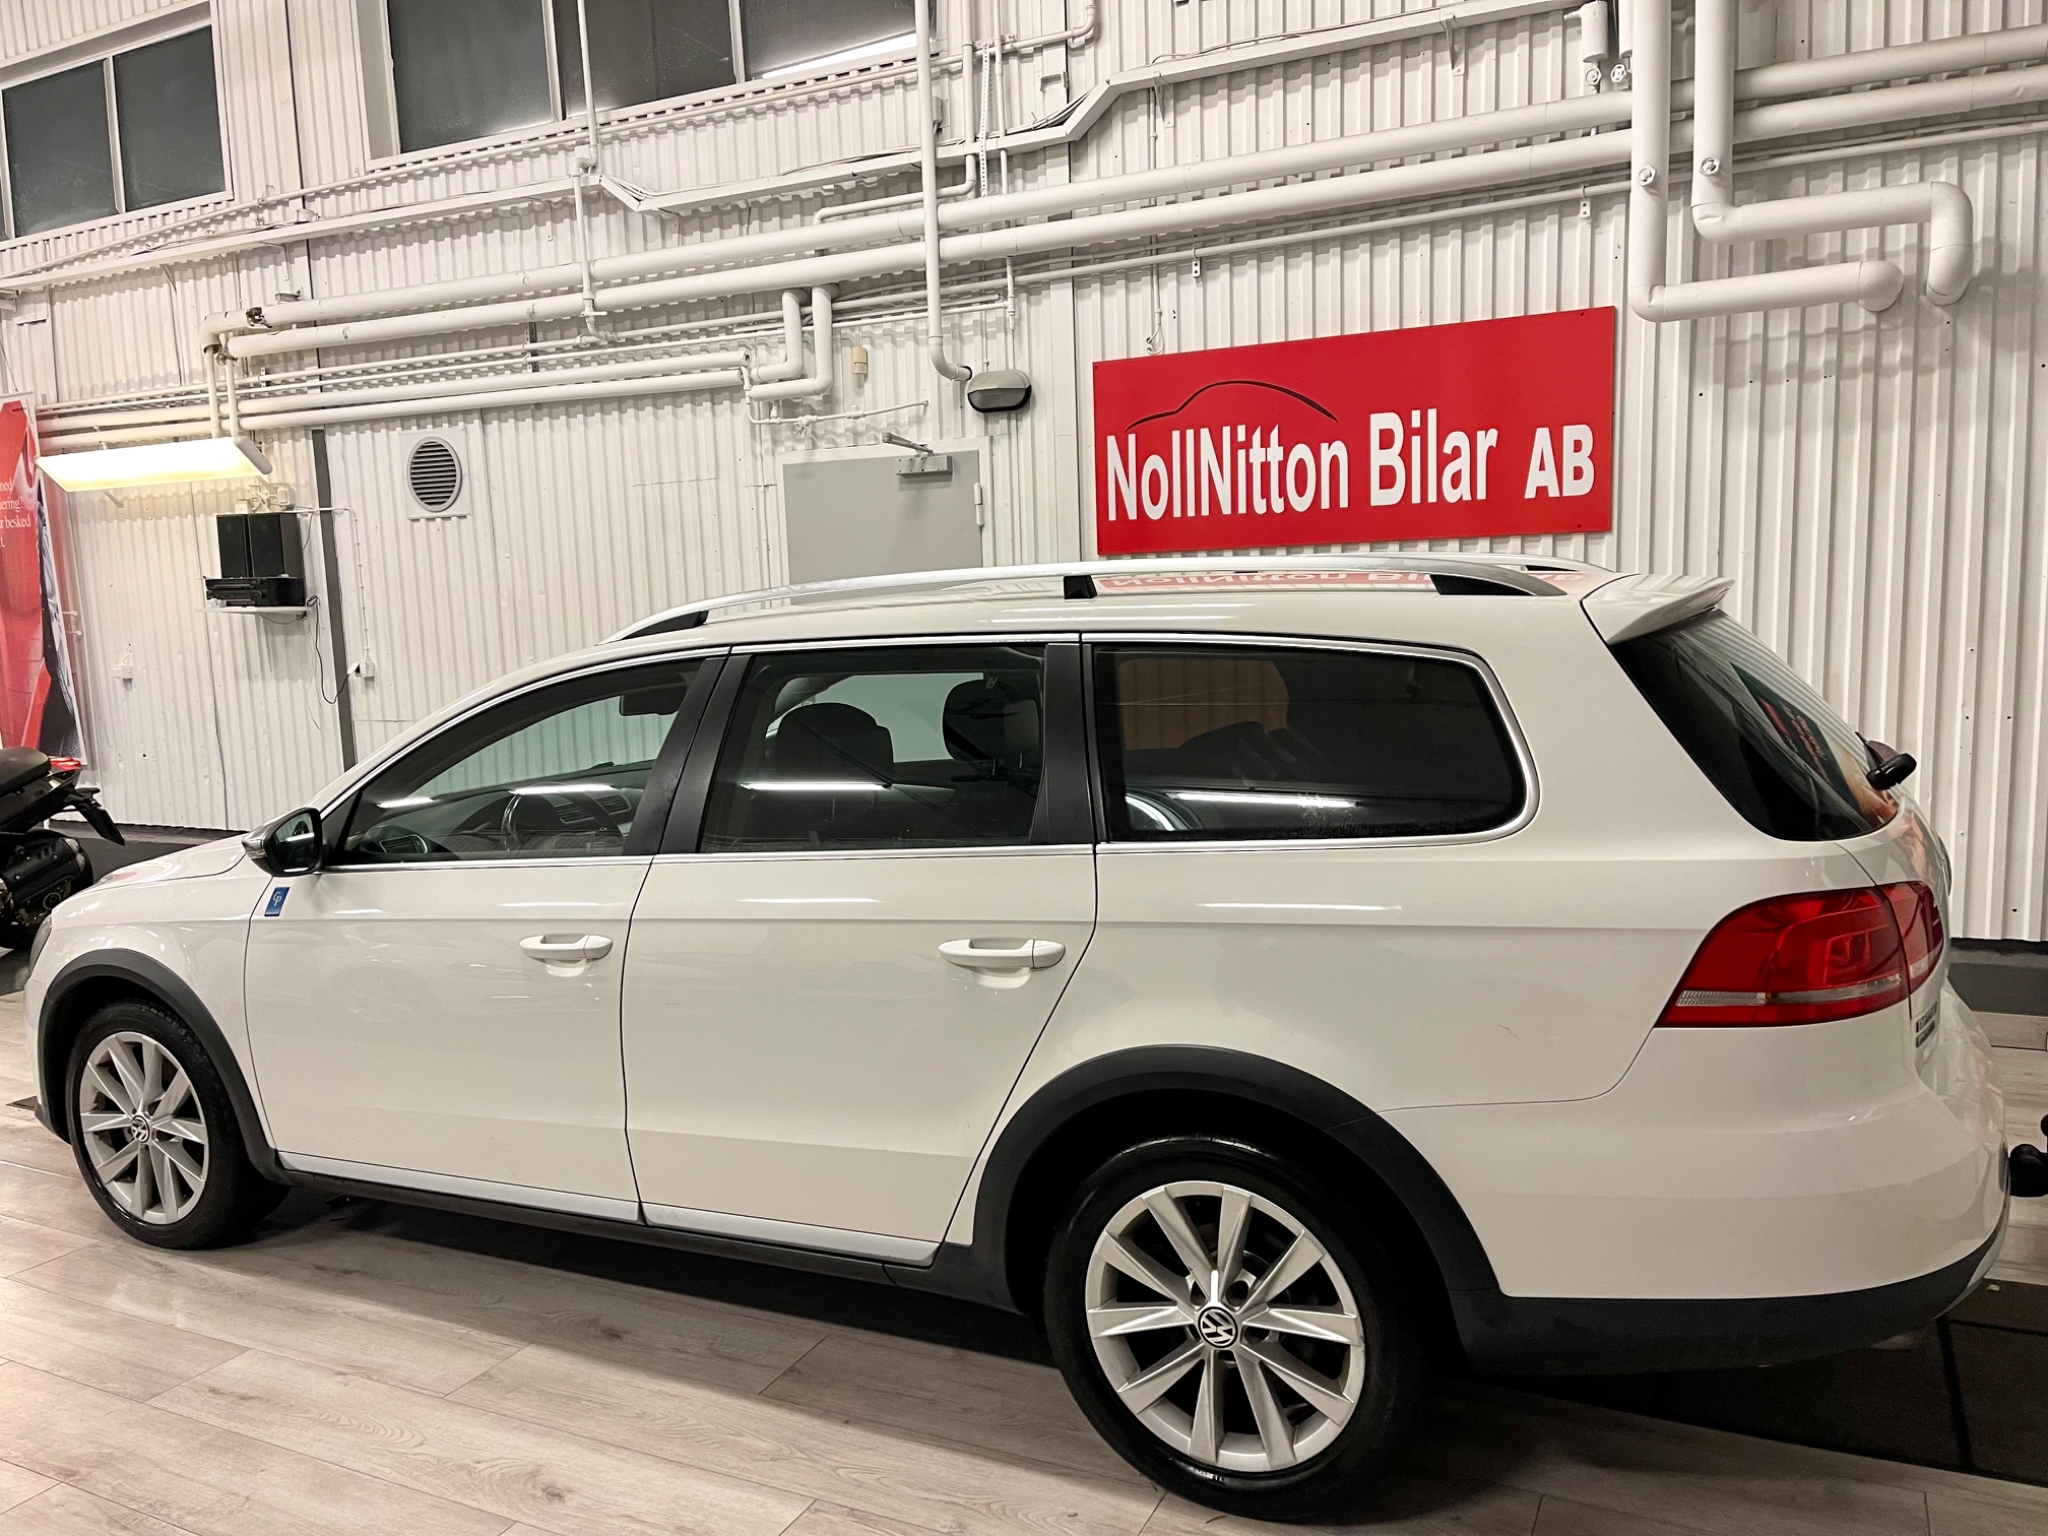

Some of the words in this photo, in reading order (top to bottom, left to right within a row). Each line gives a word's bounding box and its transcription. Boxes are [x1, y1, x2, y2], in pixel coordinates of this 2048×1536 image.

[1106, 423, 1349, 521] NollNitton
[1369, 408, 1499, 507] Bilar
[1524, 423, 1595, 500] AB
[5, 514, 31, 529] besked
